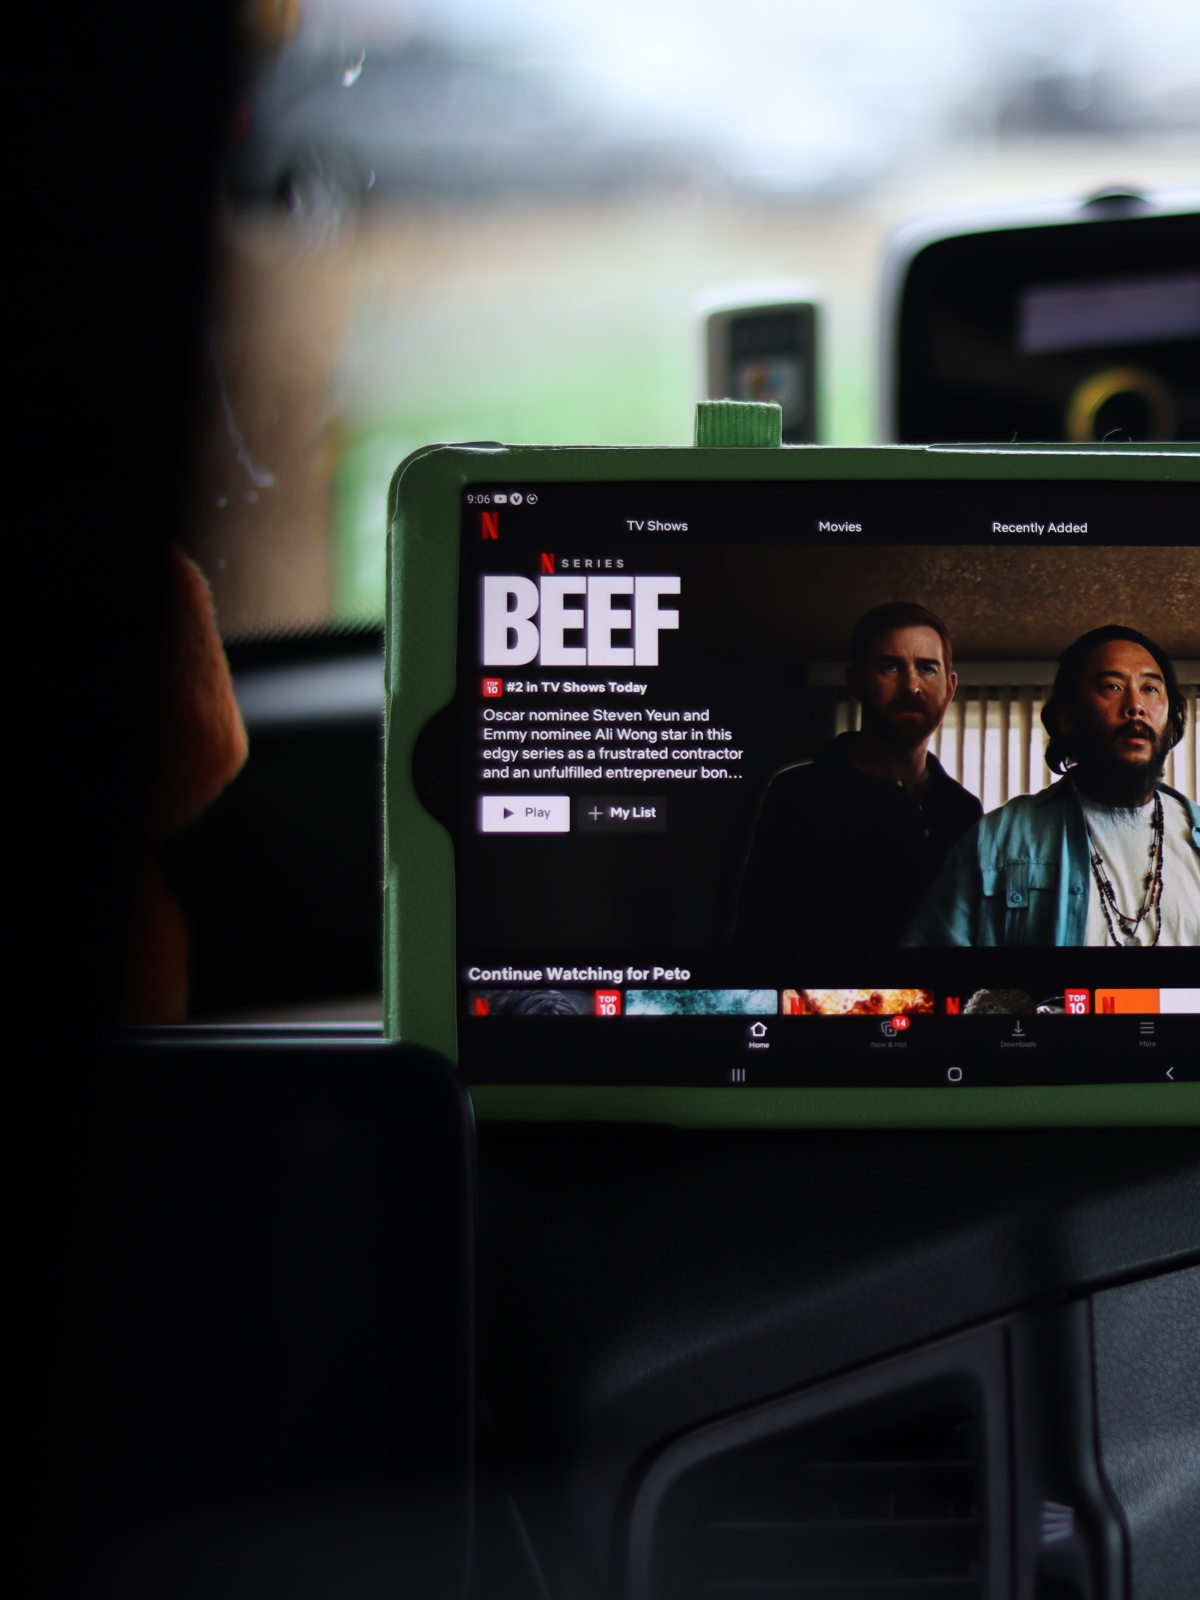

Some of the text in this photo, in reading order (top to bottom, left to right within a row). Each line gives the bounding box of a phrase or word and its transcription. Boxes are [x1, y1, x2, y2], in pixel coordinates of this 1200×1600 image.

[467, 495, 490, 504] 9:06
[482, 512, 498, 539] N
[627, 521, 688, 531] TV Shows
[819, 522, 862, 532] Movies
[993, 522, 1087, 535] Recently Added
[562, 559, 623, 568] SERIES
[483, 576, 681, 666] BEEF
[507, 682, 647, 695] #2 in TV Shows Today
[484, 709, 709, 721] Oscar nominee Steven Yeun and
[484, 728, 732, 743] Emmy nominee Ali Wong star in this
[483, 747, 743, 762] edgy series as a frustrated contractor
[483, 766, 509, 778] and
[513, 769, 529, 778] an
[534, 766, 602, 778] unfulfilled
[606, 767, 697, 781] entrepreneur
[526, 808, 550, 819] Play
[610, 807, 656, 819] My List
[468, 967, 690, 984] Continue Watching for Peto
[599, 996, 617, 1004] TOP
[600, 1004, 616, 1015] 10
[1070, 1003, 1085, 1014] 10
[895, 1018, 907, 1028] 14
[1000, 1040, 1037, 1048] Downloads
